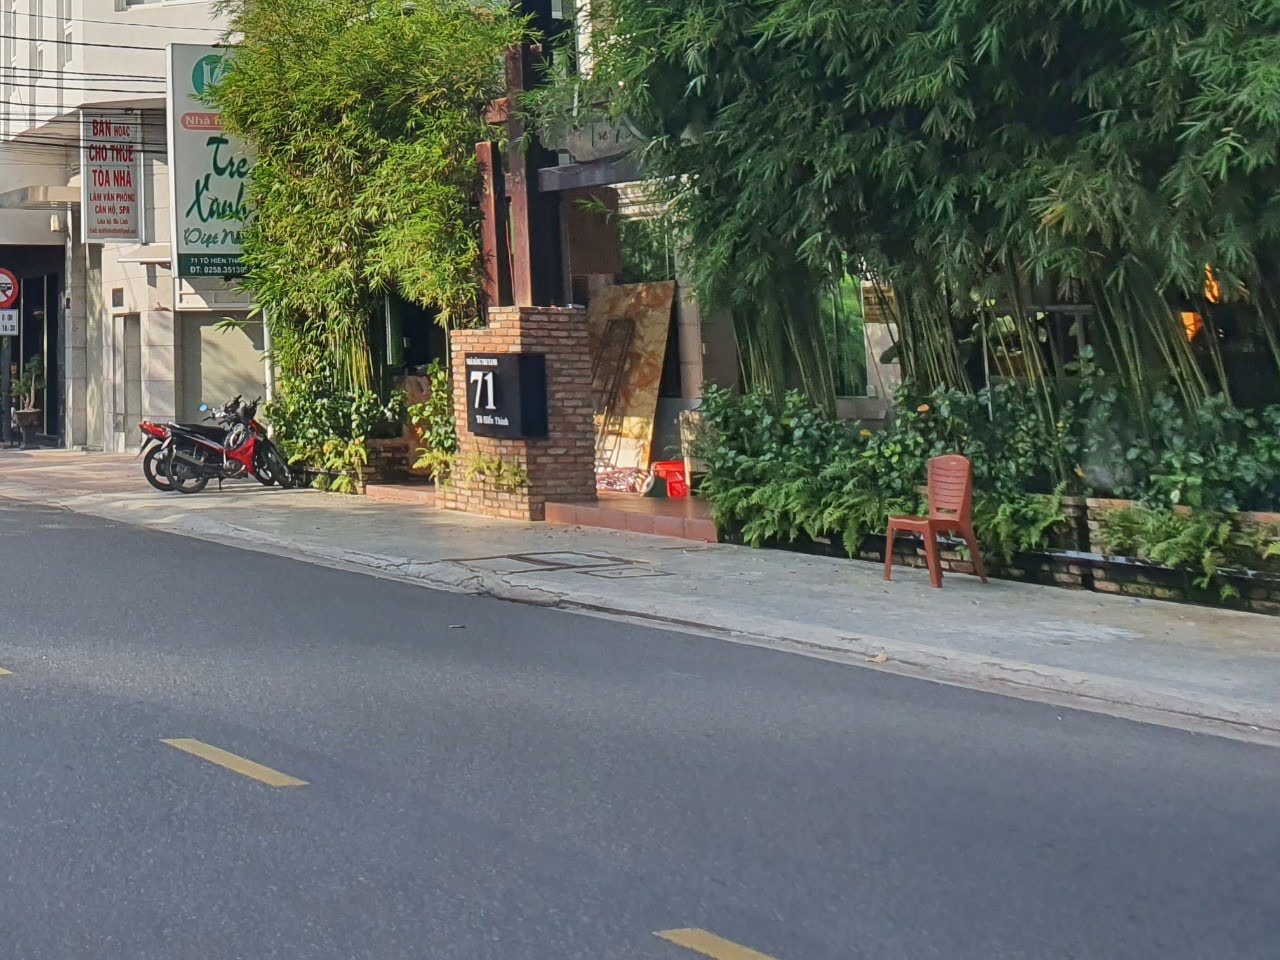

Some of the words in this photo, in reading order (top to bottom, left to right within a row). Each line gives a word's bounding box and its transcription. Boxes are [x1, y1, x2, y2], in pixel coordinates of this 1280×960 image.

[92, 114, 111, 137] BÁN
[185, 114, 210, 125] Nhà
[89, 143, 107, 162] CHO
[206, 135, 251, 179] Tre
[92, 165, 111, 187] TÒA
[113, 166, 132, 188] NHÀ
[185, 173, 252, 223] Xanh
[119, 205, 131, 215] SPA
[200, 256, 210, 264] TÔ
[470, 371, 497, 409] 71
